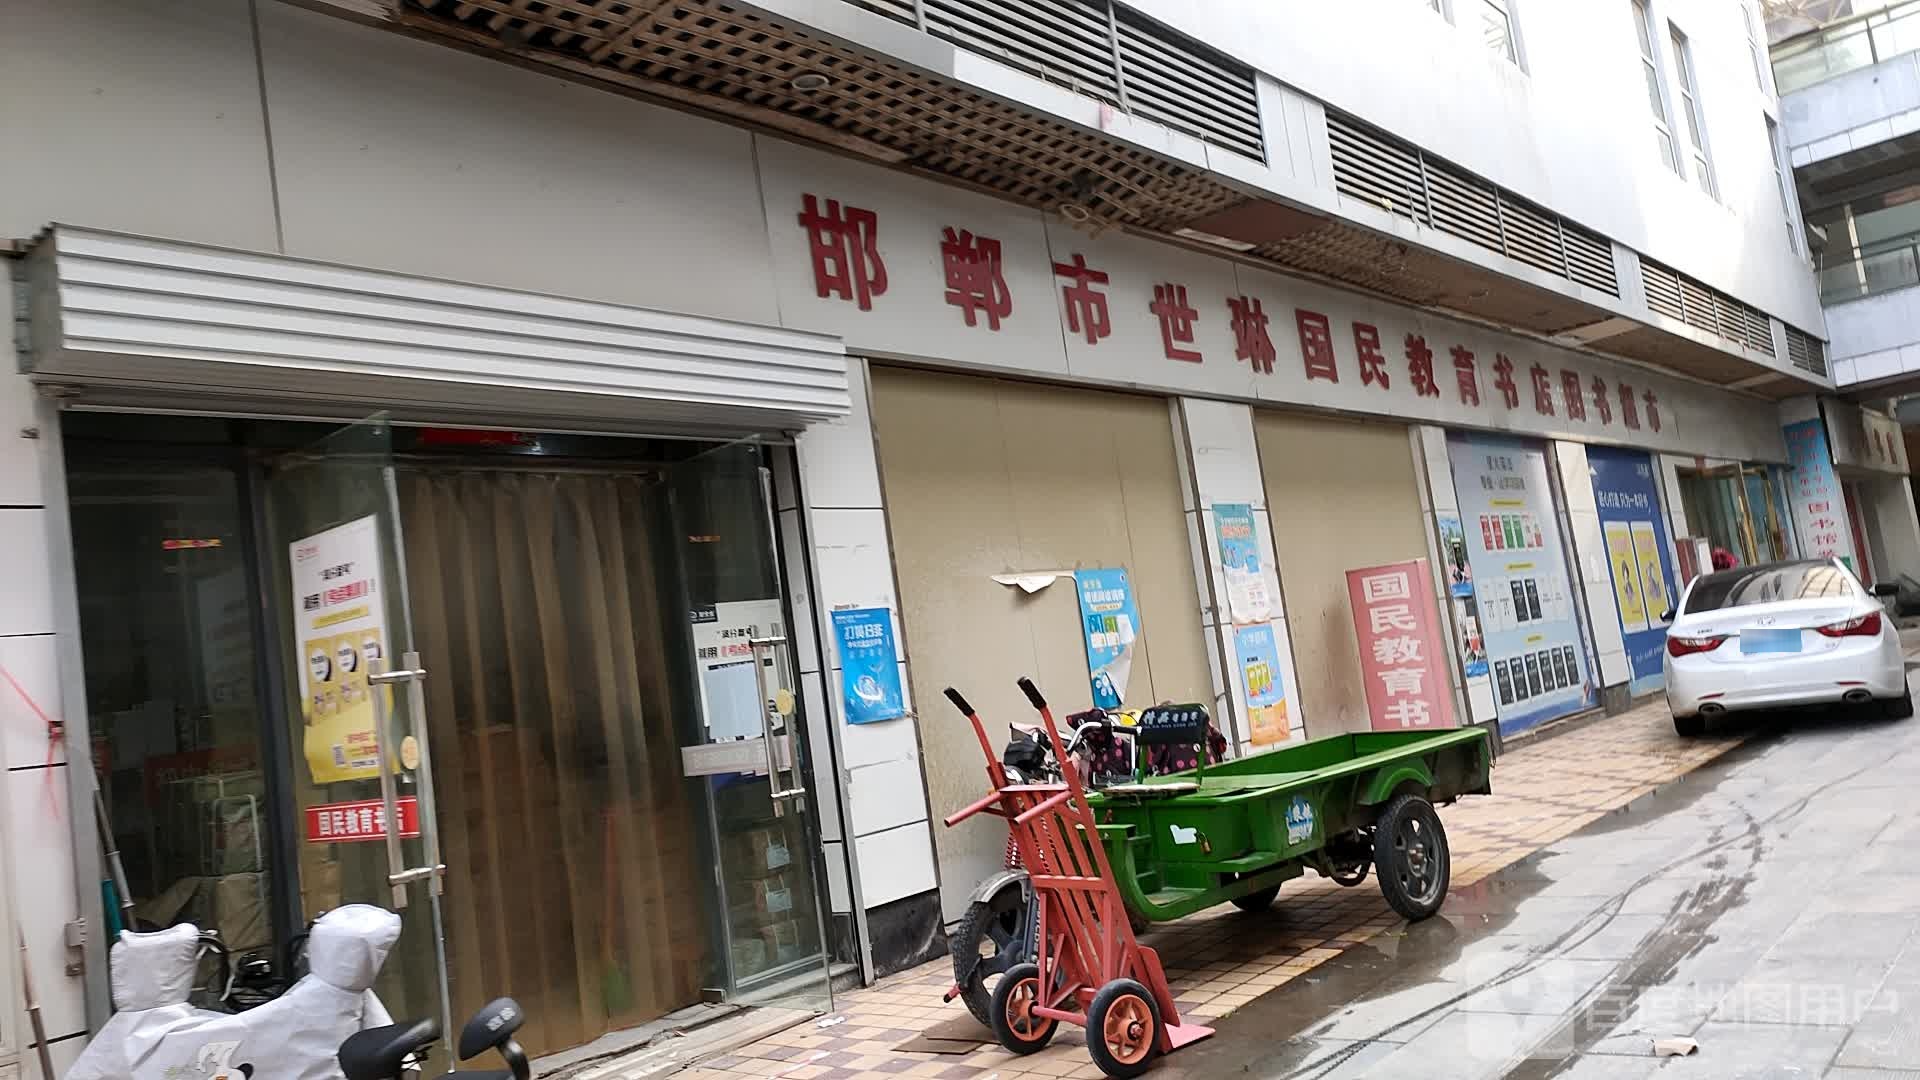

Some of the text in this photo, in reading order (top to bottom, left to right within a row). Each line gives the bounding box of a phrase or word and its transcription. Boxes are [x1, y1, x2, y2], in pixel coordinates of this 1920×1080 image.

[1362, 572, 1430, 728] 国民教育书
